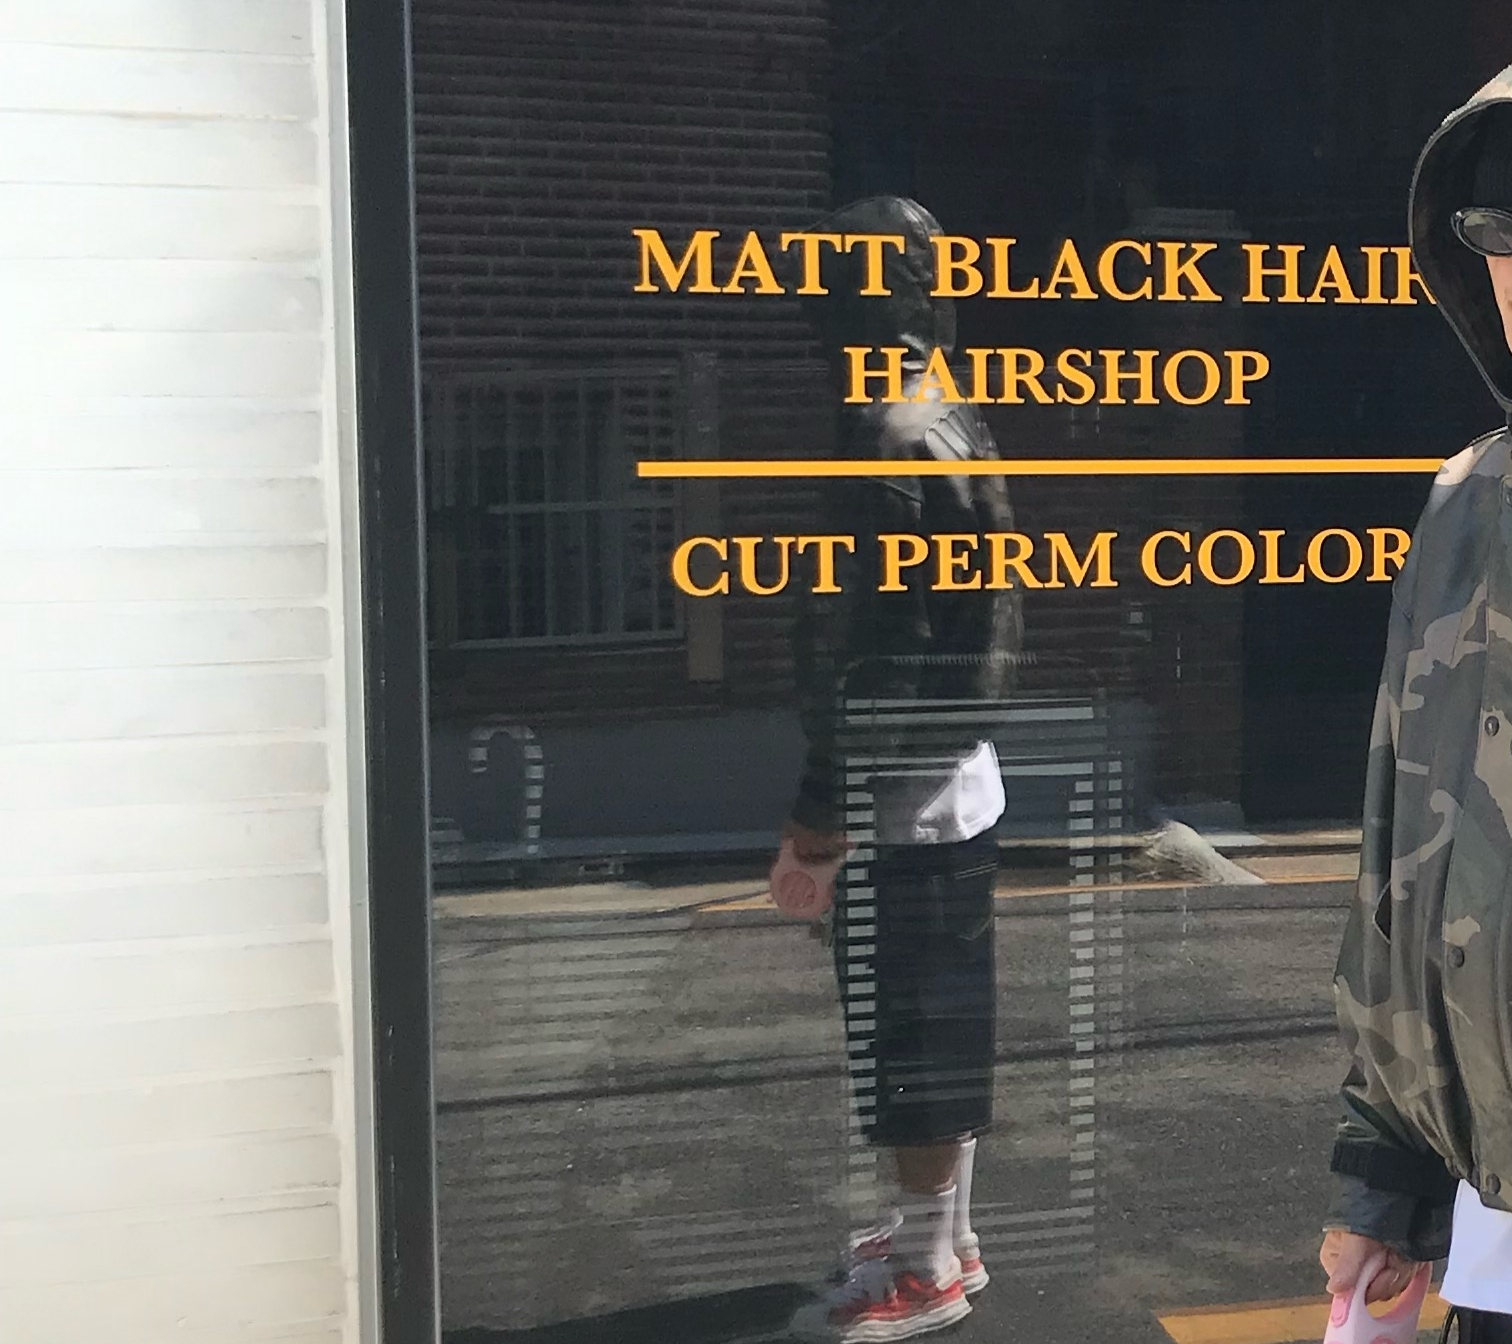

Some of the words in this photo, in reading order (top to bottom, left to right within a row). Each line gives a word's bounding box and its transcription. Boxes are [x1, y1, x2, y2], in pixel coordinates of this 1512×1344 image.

[633, 229, 905, 296] MATT
[930, 234, 1222, 302] BLACK
[844, 346, 1270, 405] HAIRSHOP
[671, 535, 855, 597] CUT
[878, 532, 1118, 592] PERM
[1141, 527, 1412, 587] COLOR
